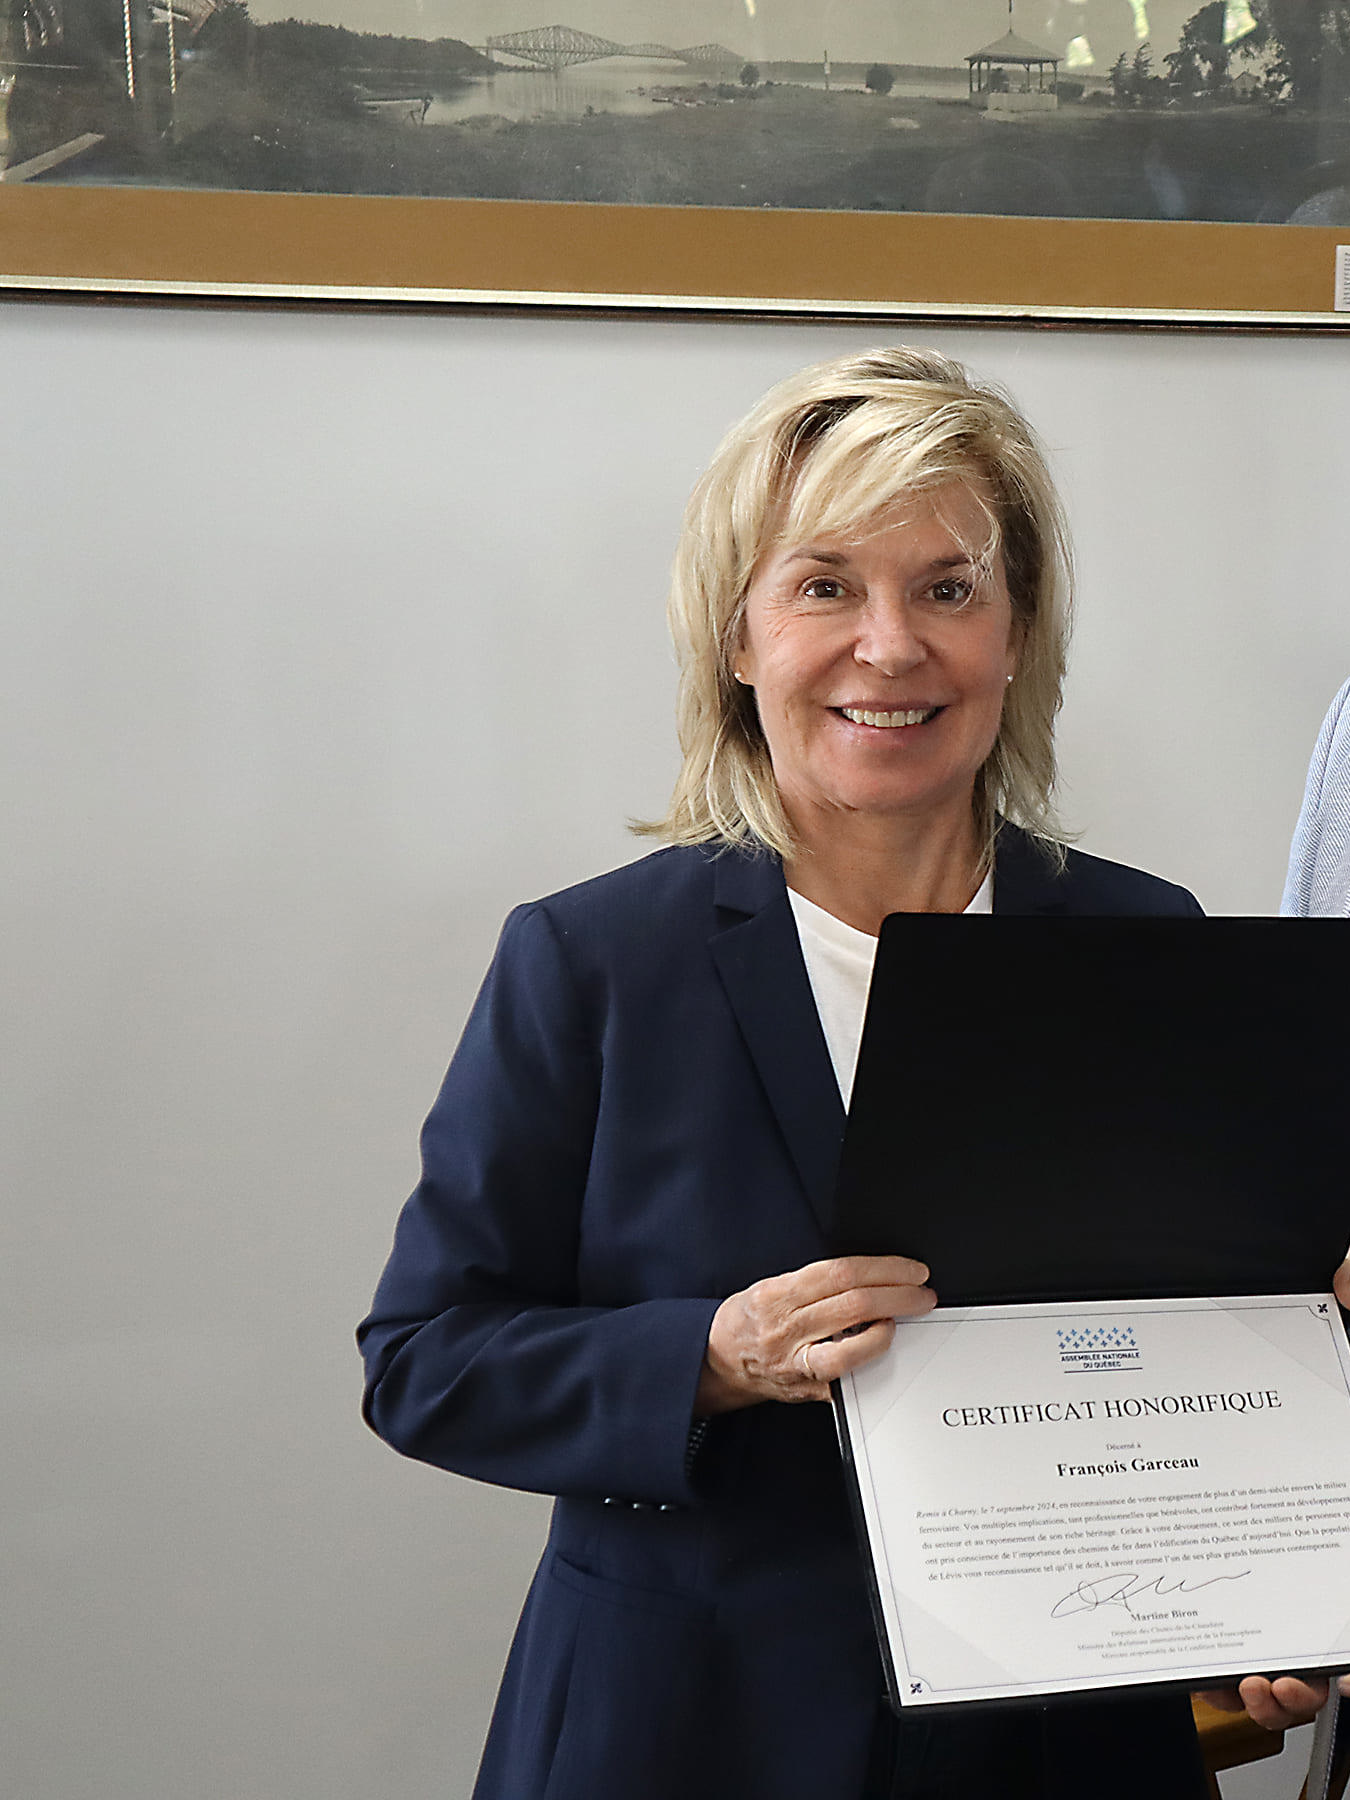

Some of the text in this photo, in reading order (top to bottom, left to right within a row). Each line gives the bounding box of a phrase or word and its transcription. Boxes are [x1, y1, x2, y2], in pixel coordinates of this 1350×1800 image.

[1061, 1353, 1100, 1362] ASSEMBLÉE
[943, 1390, 1282, 1428] CERTIFICAT HONORIFIQUE
[1057, 1456, 1200, 1479] François Garceau
[1070, 1498, 1125, 1507] reconnaissance
[1138, 1494, 1156, 1502] votre
[1158, 1490, 1201, 1502] engagement
[1213, 1489, 1228, 1499] plus
[1323, 1481, 1346, 1489] milieu
[934, 1540, 961, 1548] secteur
[985, 1534, 1035, 1546] rayonnement
[1064, 1530, 1082, 1538] riche
[1152, 1524, 1170, 1532] votre
[1232, 1517, 1247, 1525] sont
[1264, 1514, 1292, 1523] milliers
[1305, 1512, 1340, 1522] personnes
[981, 1520, 1016, 1530] multiples
[1084, 1511, 1144, 1524] professionnelles
[1145, 1511, 1158, 1519] que
[1201, 1505, 1212, 1513] ont
[1250, 1500, 1284, 1510] fortement
[924, 1557, 937, 1566] ont
[940, 1556, 954, 1566] pris
[956, 1554, 999, 1563] conscience
[1077, 1545, 1108, 1554] chemins
[1211, 1534, 1239, 1545] Québec
[1294, 1529, 1310, 1539] Que
[940, 1572, 961, 1580] Lévis
[983, 1567, 1040, 1577] reconnaissance
[1043, 1564, 1053, 1572] tel
[1111, 1558, 1133, 1566] savoir
[1205, 1551, 1221, 1561] plus
[1223, 1548, 1247, 1559] grands
[1130, 1608, 1198, 1623] Martine Biron
